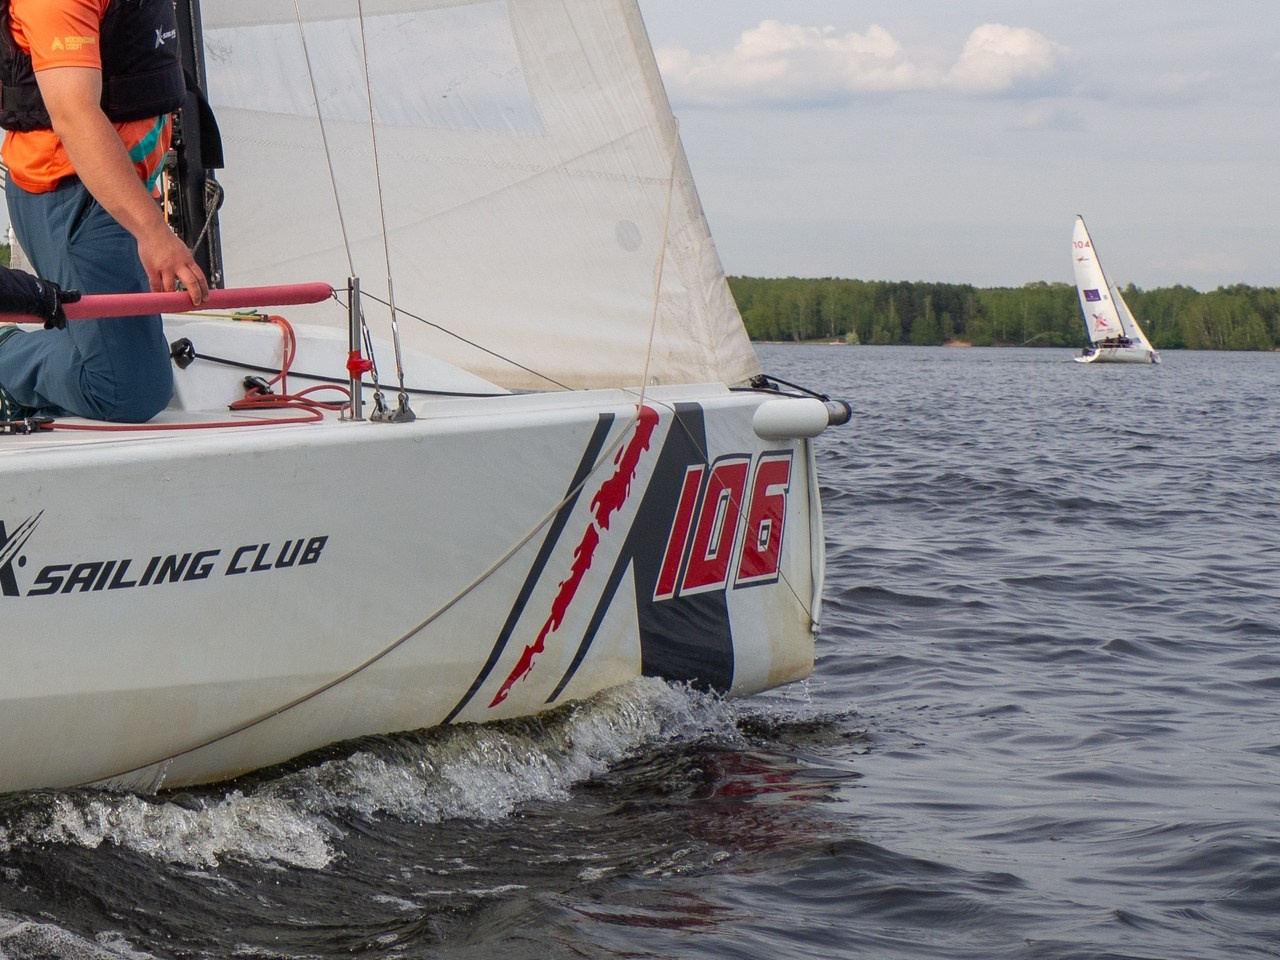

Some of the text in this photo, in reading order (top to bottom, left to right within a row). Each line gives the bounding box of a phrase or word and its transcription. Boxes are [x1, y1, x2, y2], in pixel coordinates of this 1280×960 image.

[1073, 240, 1091, 249] 104
[652, 449, 794, 602] 106
[26, 549, 222, 597] SAILING
[224, 535, 329, 576] CLUB
